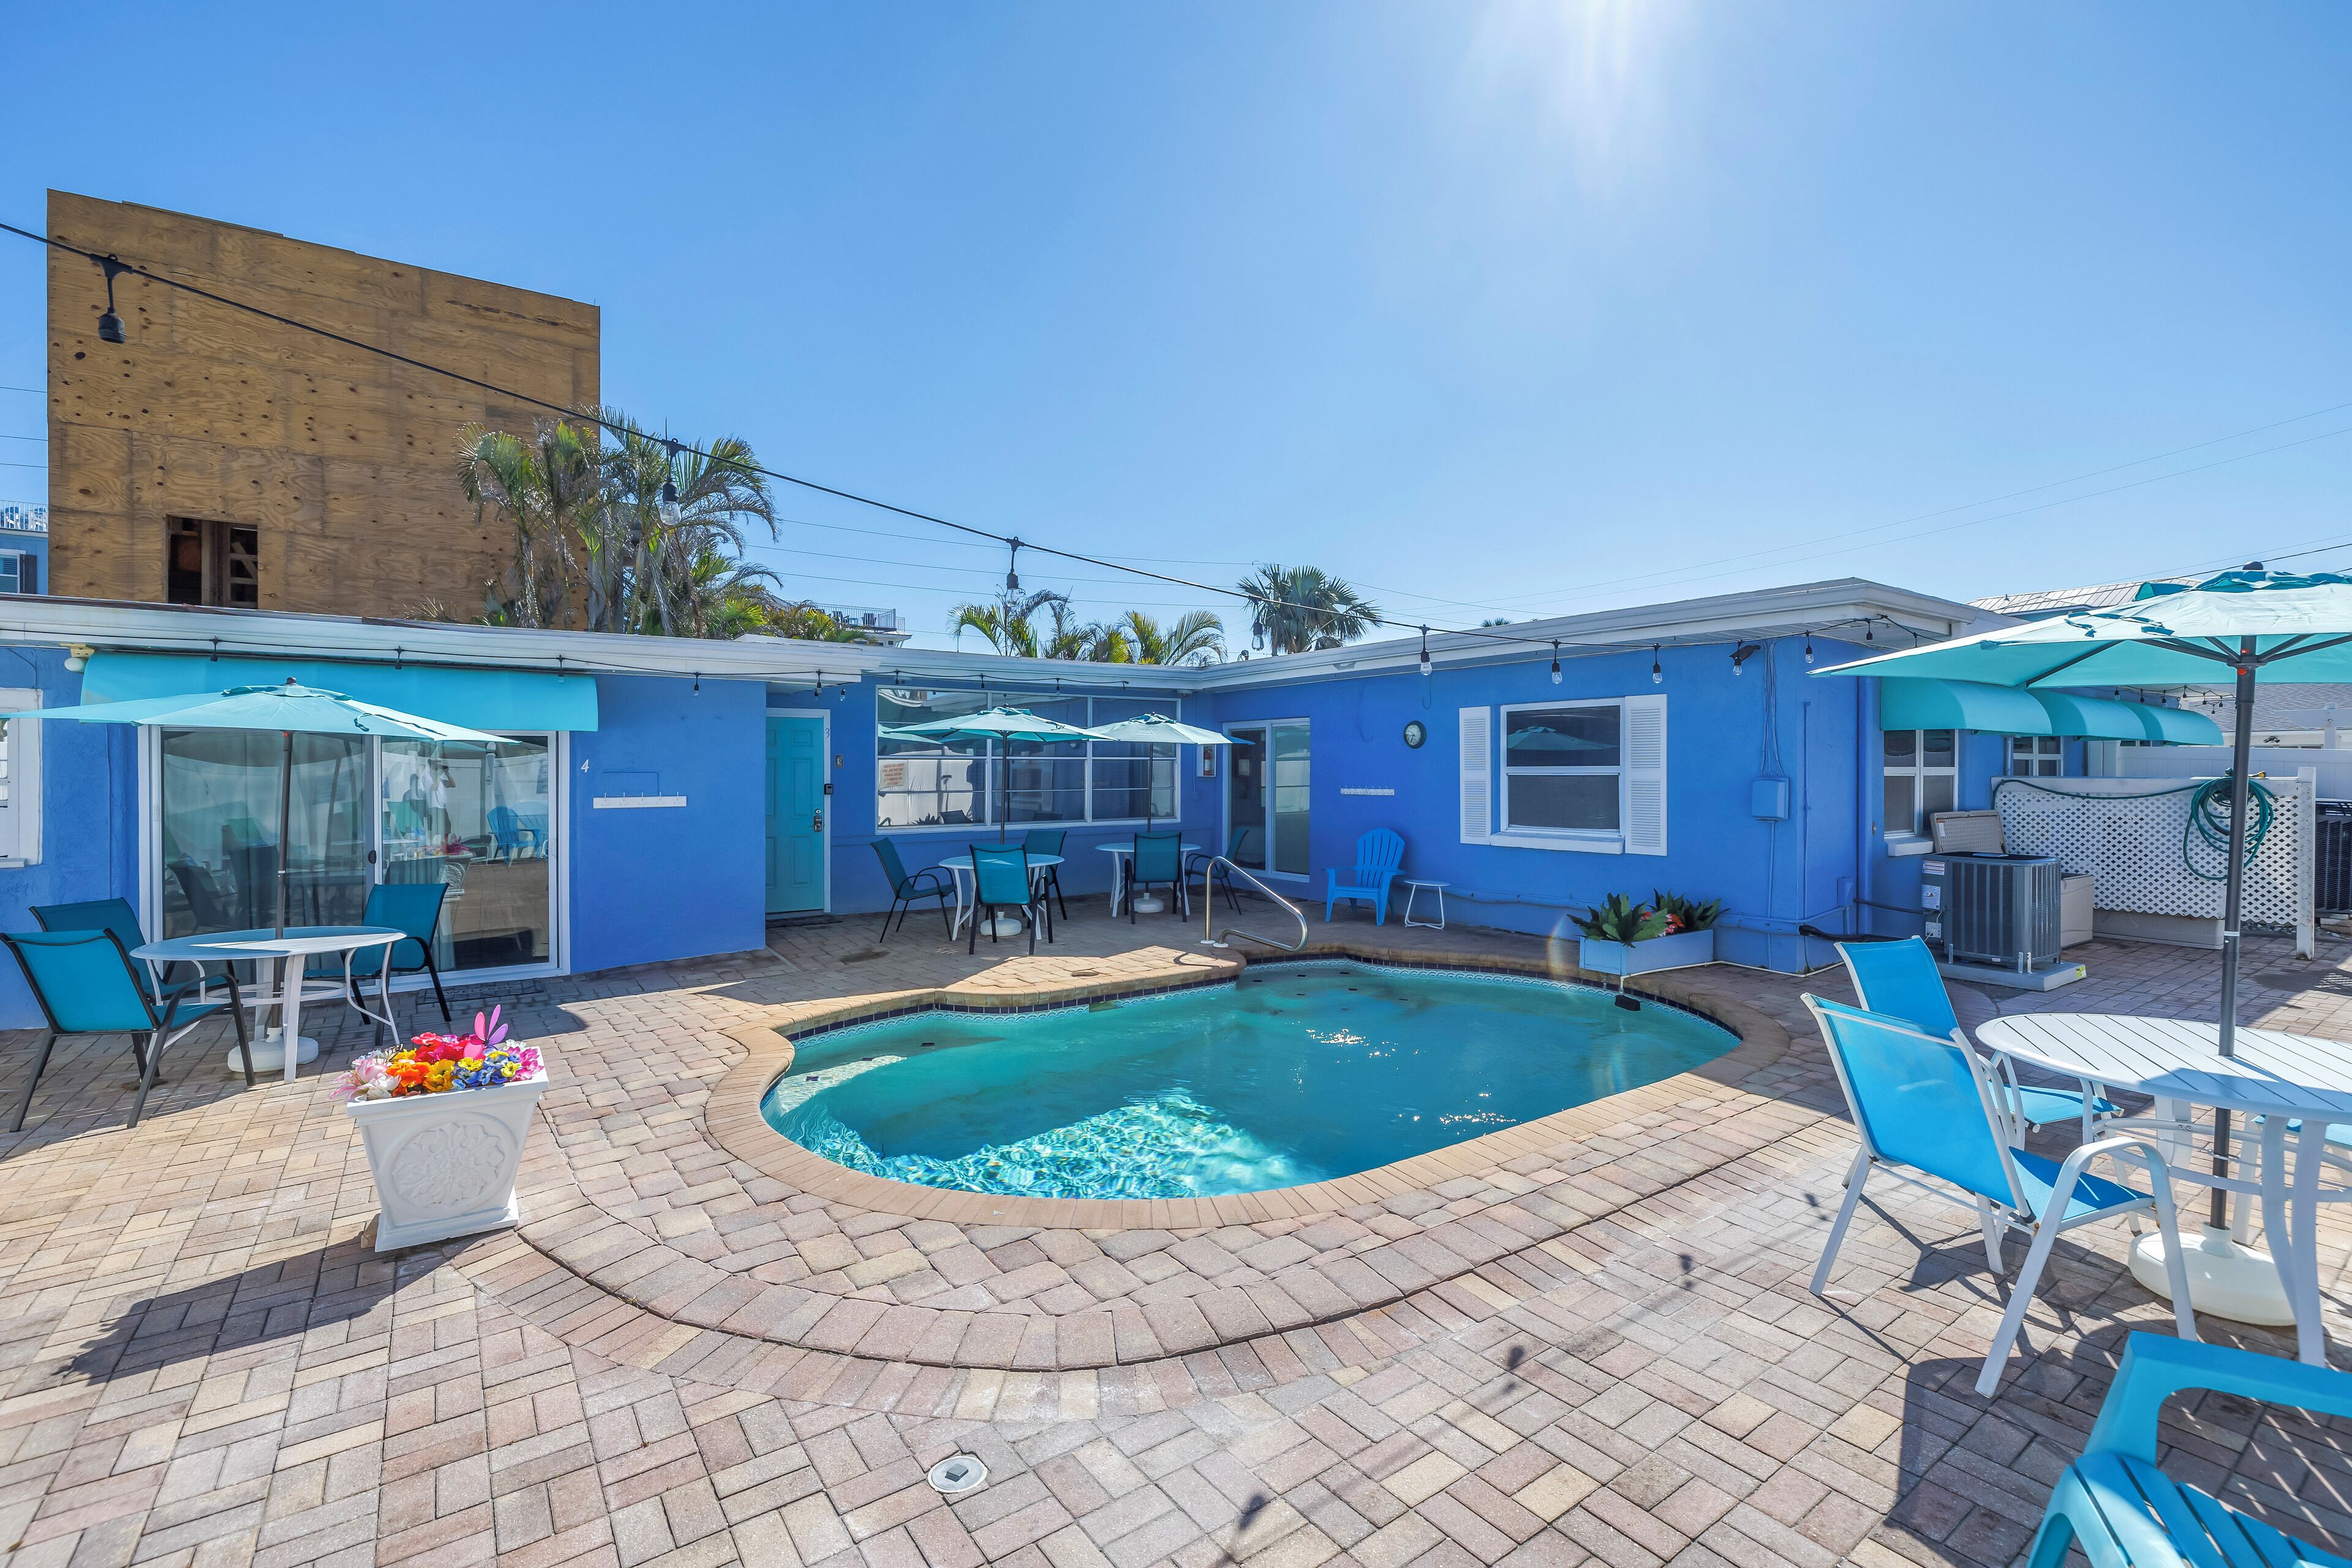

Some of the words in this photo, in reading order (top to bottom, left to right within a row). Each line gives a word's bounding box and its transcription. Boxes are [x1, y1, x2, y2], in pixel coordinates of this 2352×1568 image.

[825, 728, 830, 739] 3
[581, 759, 589, 773] 4
[447, 986, 512, 995] WELCOME
